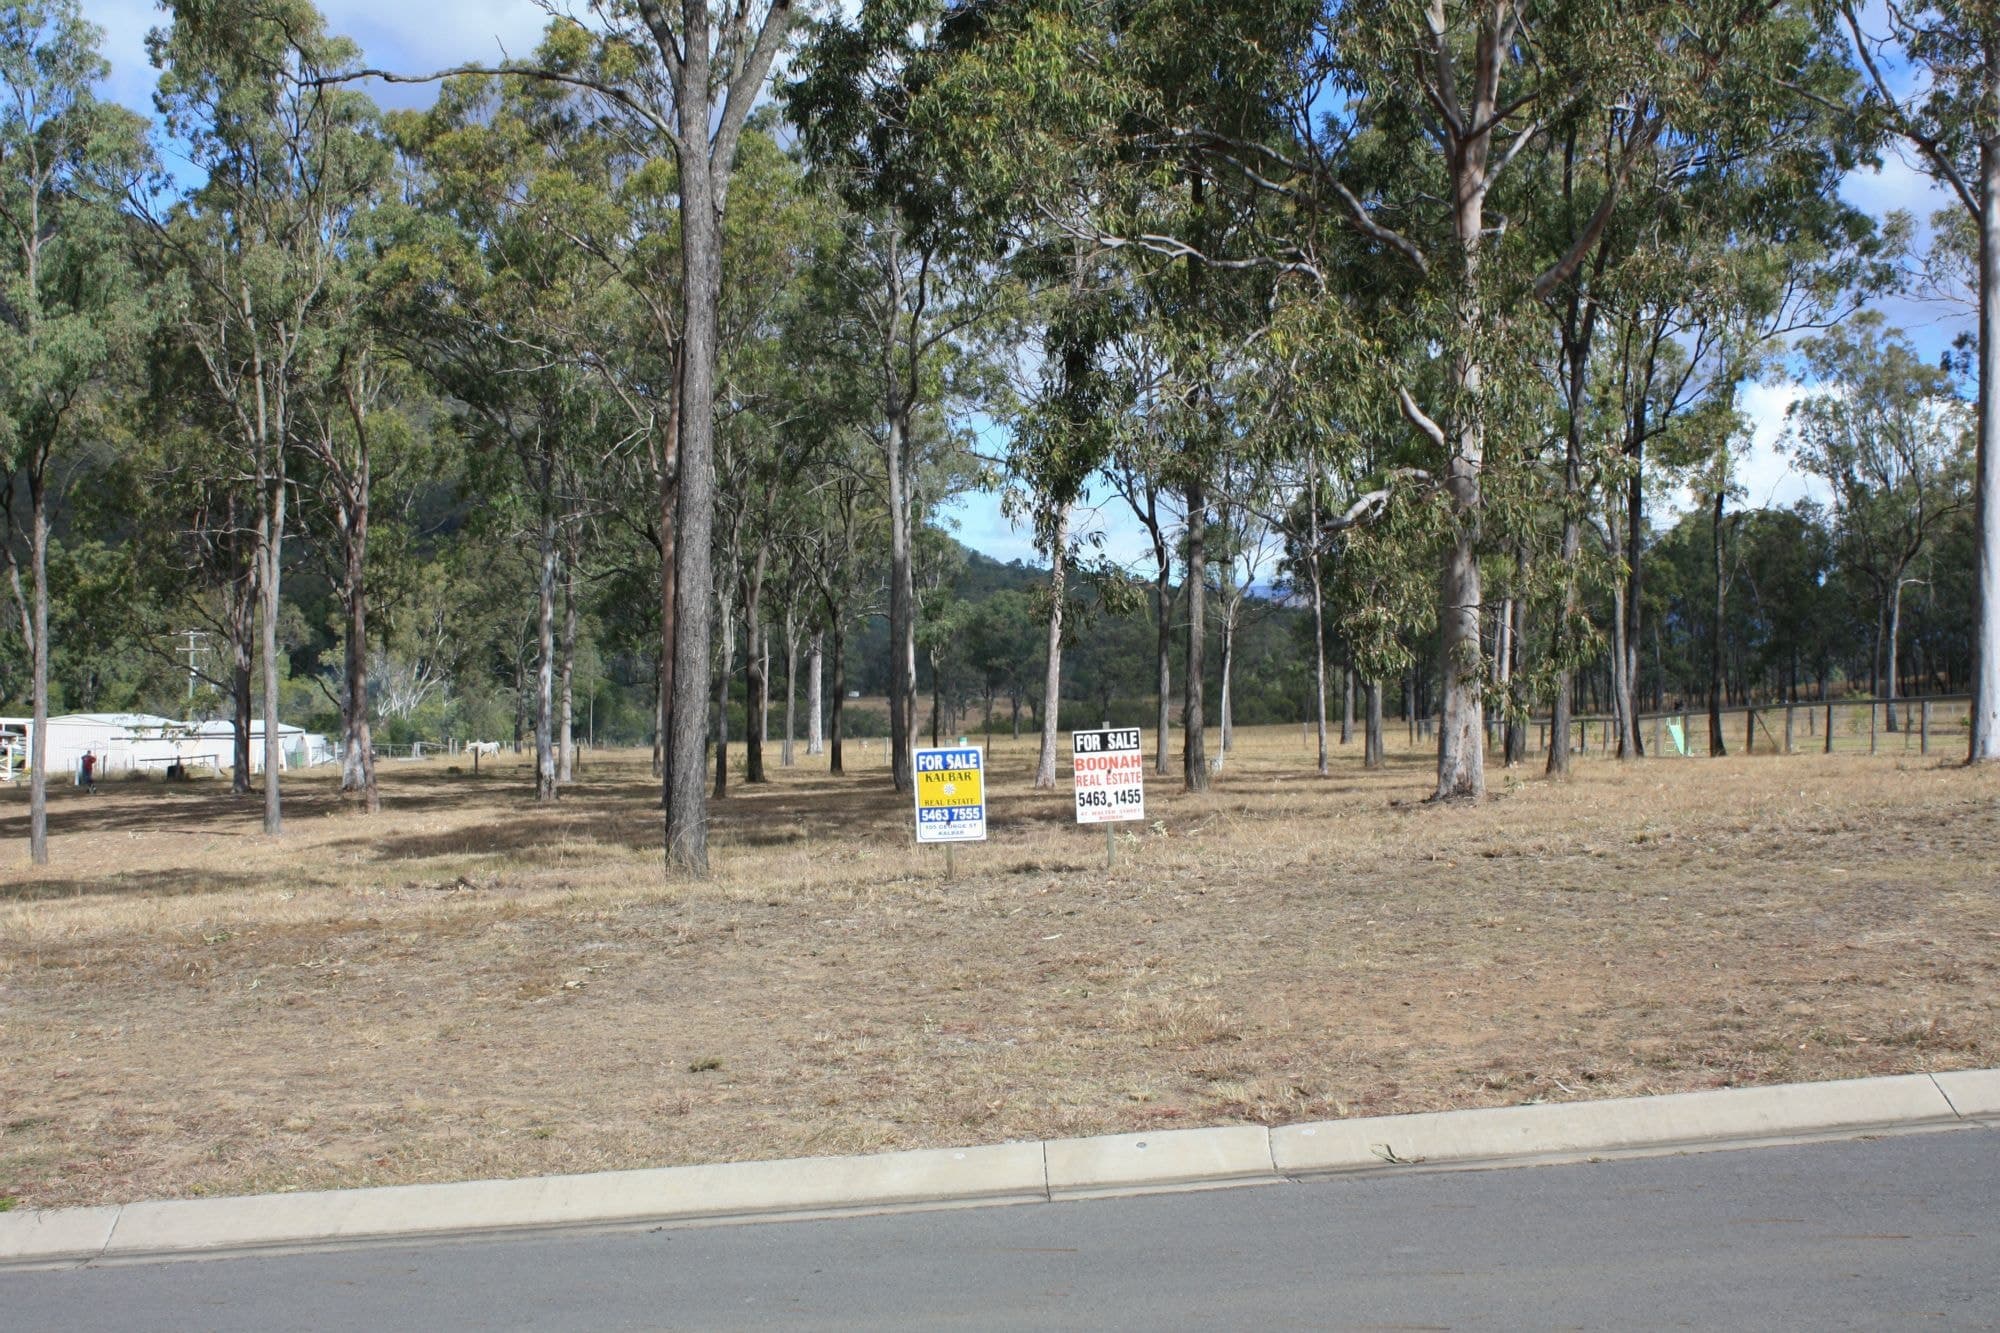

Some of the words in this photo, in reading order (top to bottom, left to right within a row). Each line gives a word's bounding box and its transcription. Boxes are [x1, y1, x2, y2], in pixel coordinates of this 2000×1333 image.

[1076, 734, 1101, 751] FOR
[1107, 732, 1137, 749] SALE
[918, 754, 943, 770] FOR
[946, 753, 977, 769] SALE
[1075, 754, 1141, 771] BOONAH
[925, 771, 971, 783] KALBAR
[1076, 774, 1101, 787] REAL
[1106, 771, 1141, 785] ESTATE
[947, 797, 975, 805] ESTATE
[1078, 790, 1107, 807] 5463
[1113, 789, 1141, 805] 1455
[921, 808, 949, 821] 5463
[952, 807, 980, 820] 7555
